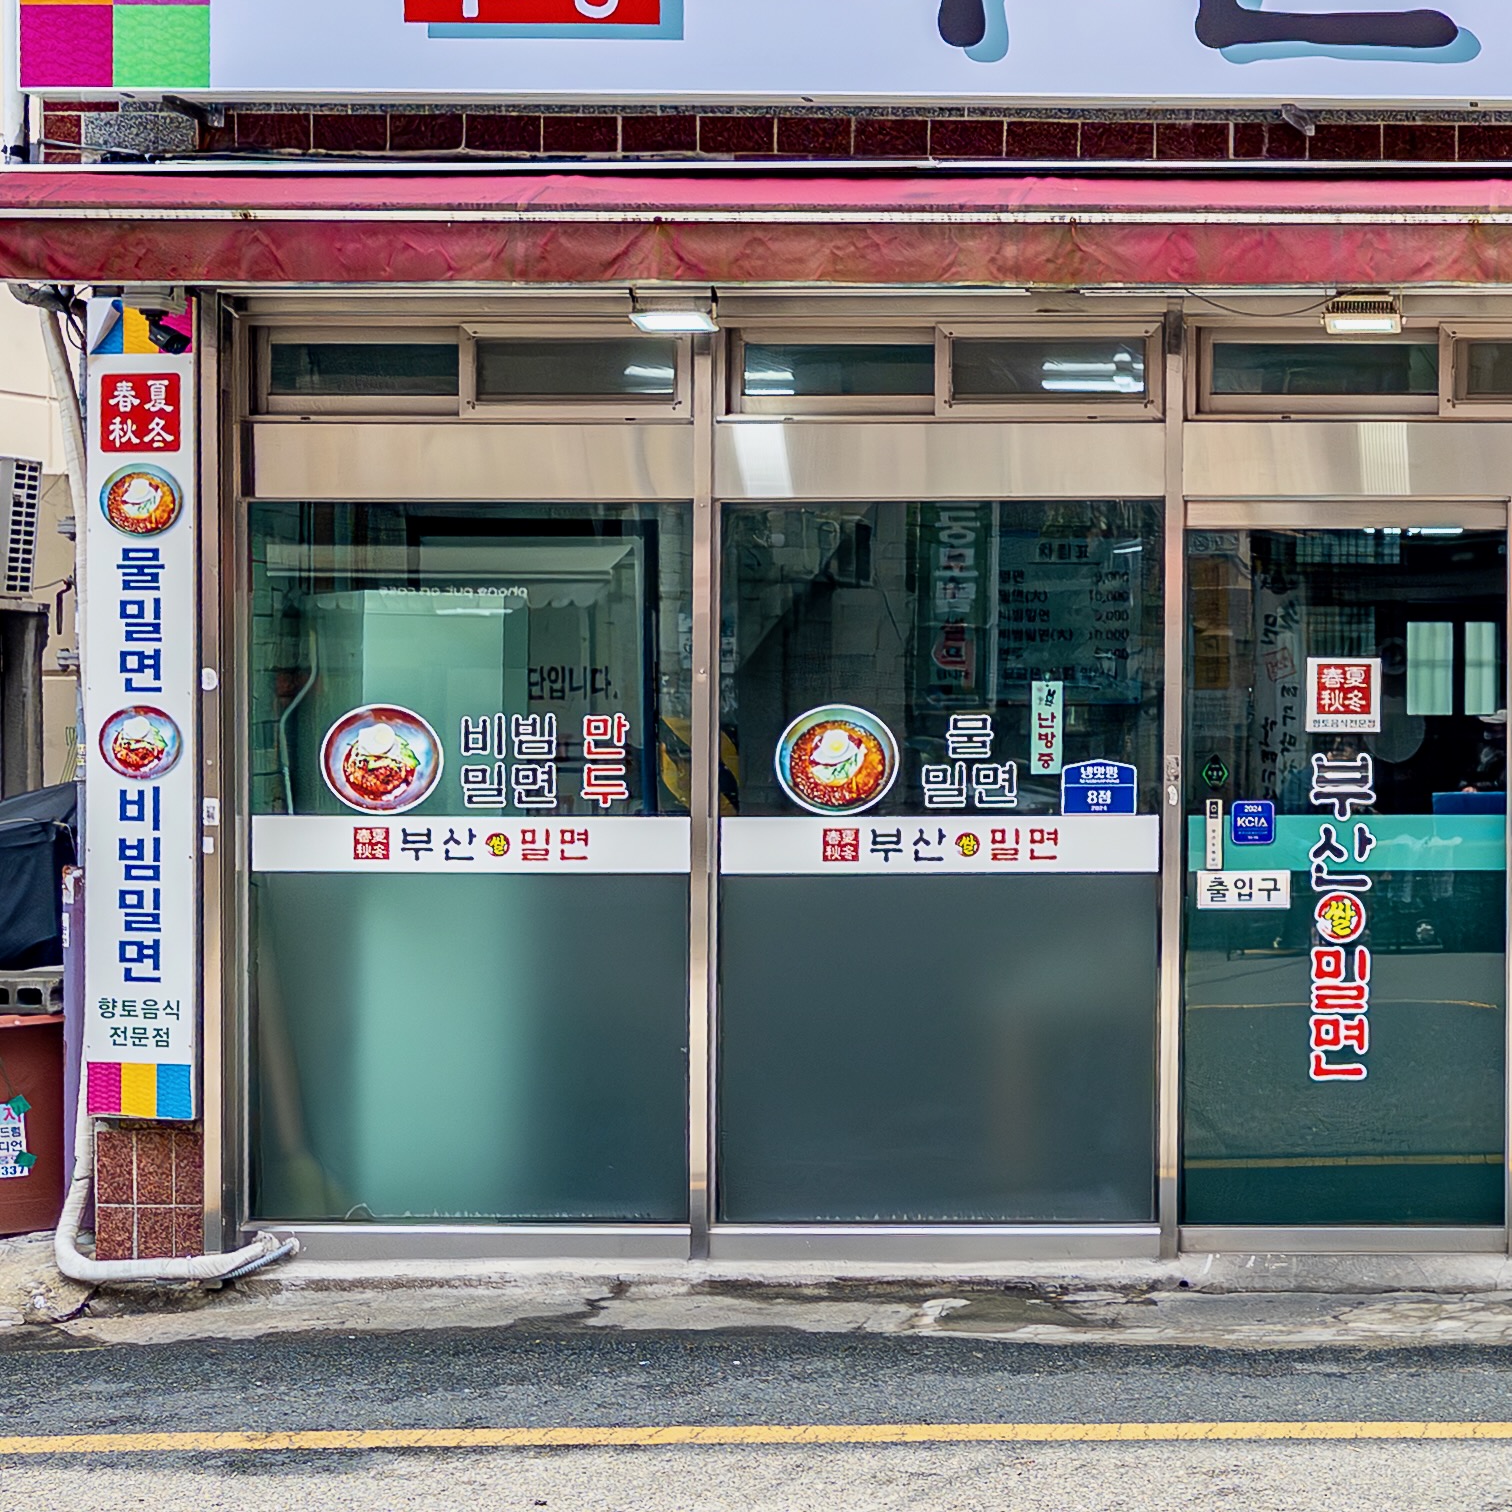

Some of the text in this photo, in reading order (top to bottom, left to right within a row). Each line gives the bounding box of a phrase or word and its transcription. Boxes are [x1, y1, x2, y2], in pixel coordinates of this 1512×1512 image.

[116, 546, 166, 694] 물밀면
[1037, 712, 1057, 769] 난방중
[581, 712, 631, 808] 만두
[1236, 816, 1269, 828] KCIA
[1243, 804, 1262, 813] 2024
[400, 827, 477, 861] 부산
[520, 828, 589, 861] 밀면
[870, 828, 947, 863] 부산
[990, 828, 1059, 862] 밀면
[117, 785, 162, 983] 비빔밀면
[1206, 877, 1281, 902] 출입구
[98, 997, 180, 1021] 향토음식
[109, 1025, 171, 1048] 전문점
